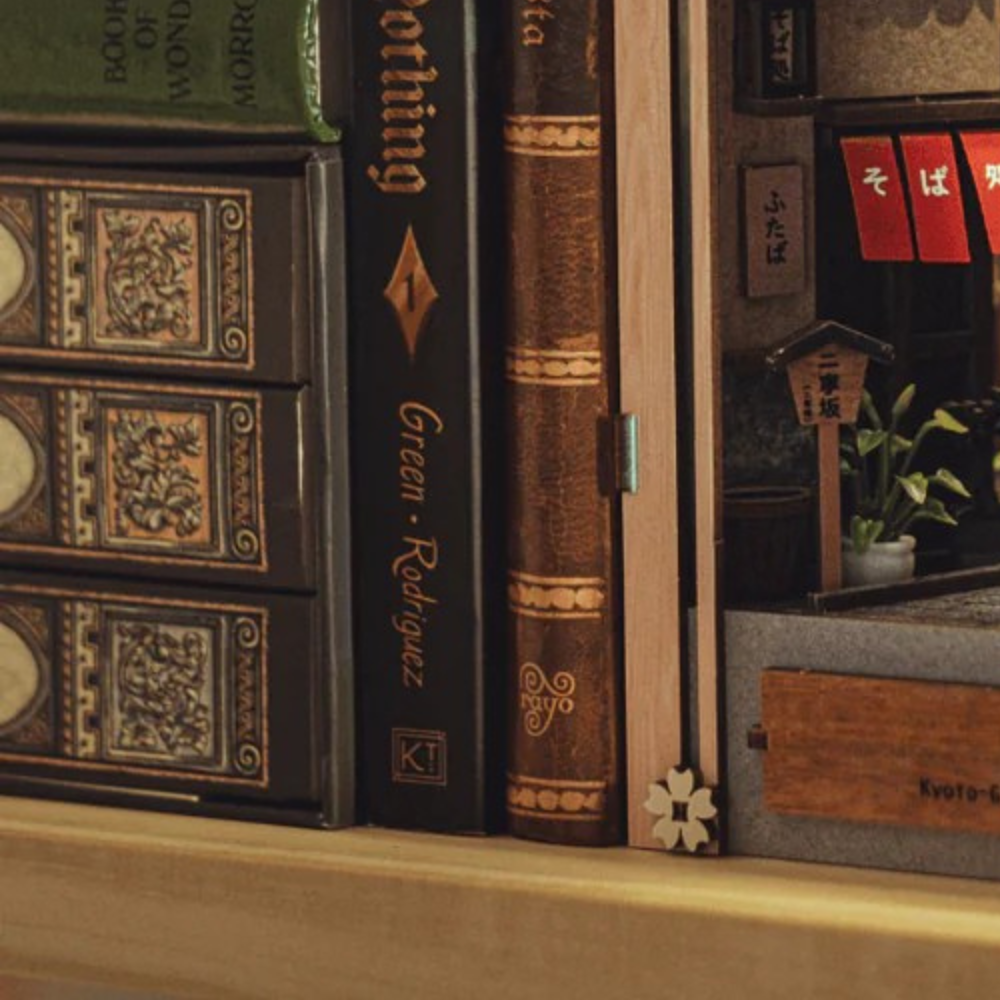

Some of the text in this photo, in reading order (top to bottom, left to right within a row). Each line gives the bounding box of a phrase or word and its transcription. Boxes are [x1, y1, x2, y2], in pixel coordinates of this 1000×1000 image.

[134, 6, 158, 50] OF
[764, 191, 787, 266] ふたば
[402, 273, 415, 312] 1
[391, 400, 444, 688] Green Rodriguez
